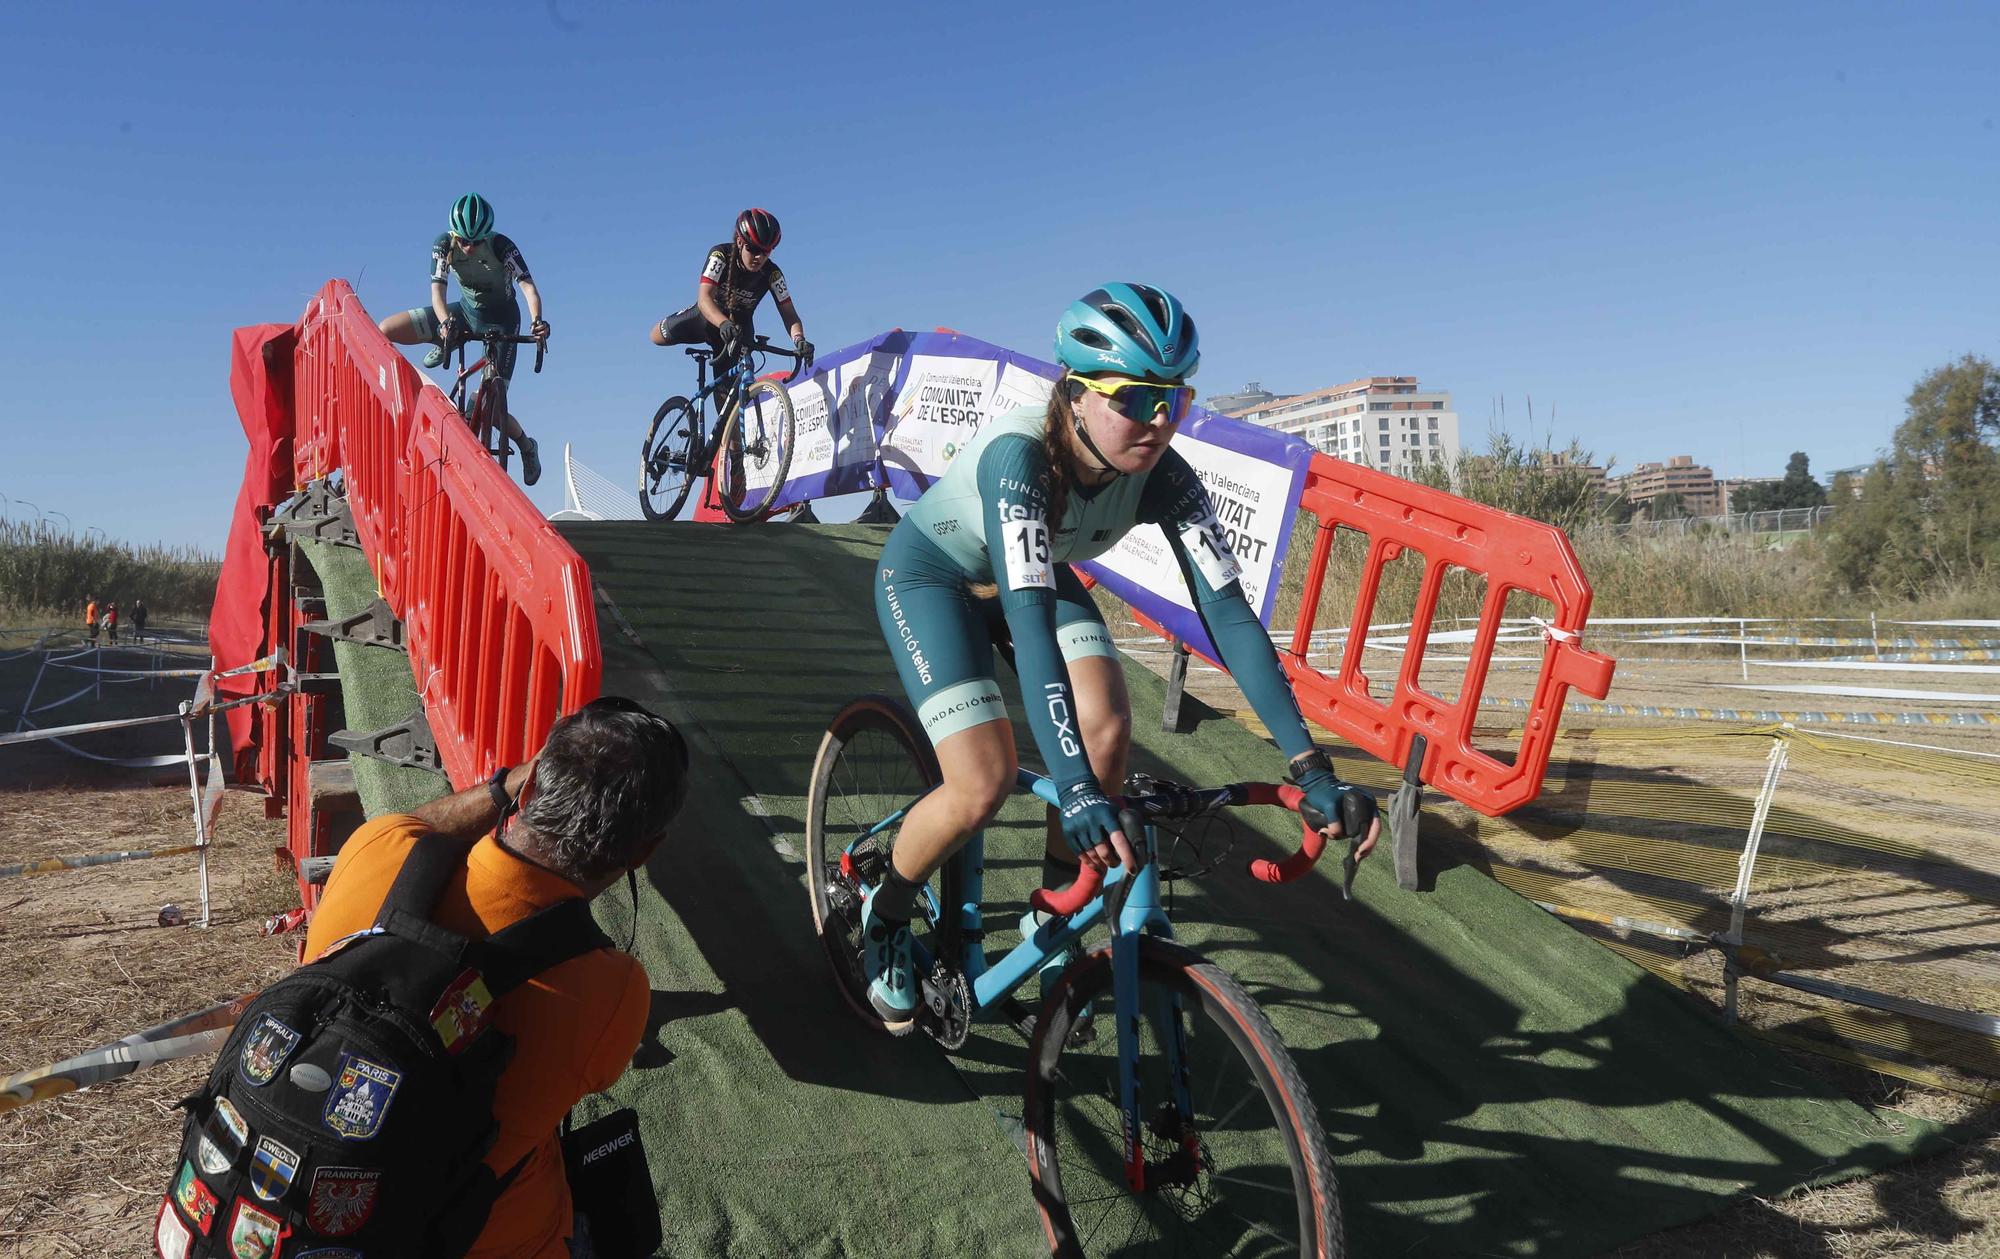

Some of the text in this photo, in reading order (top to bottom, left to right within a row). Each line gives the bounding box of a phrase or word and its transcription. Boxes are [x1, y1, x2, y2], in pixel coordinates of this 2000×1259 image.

[710, 261, 723, 274] 33
[775, 280, 787, 294] 33
[920, 385, 982, 408] COMUNITAT
[917, 404, 929, 421] DE
[1211, 471, 1260, 504] Valenciana
[932, 519, 962, 537] GSPORT
[1017, 526, 1049, 564] 15
[1124, 533, 1164, 556] GENERALITAT
[1199, 521, 1233, 562] 15
[1121, 541, 1159, 566] VALENCIANA
[885, 584, 933, 687] FUNDACIÓ teika
[265, 1018, 295, 1042] UPPSALA
[355, 1062, 389, 1081] PARIS
[262, 1140, 297, 1167] SWEDEN
[583, 1132, 634, 1166] NEEWER
[318, 1170, 382, 1180] FRANKFURT
